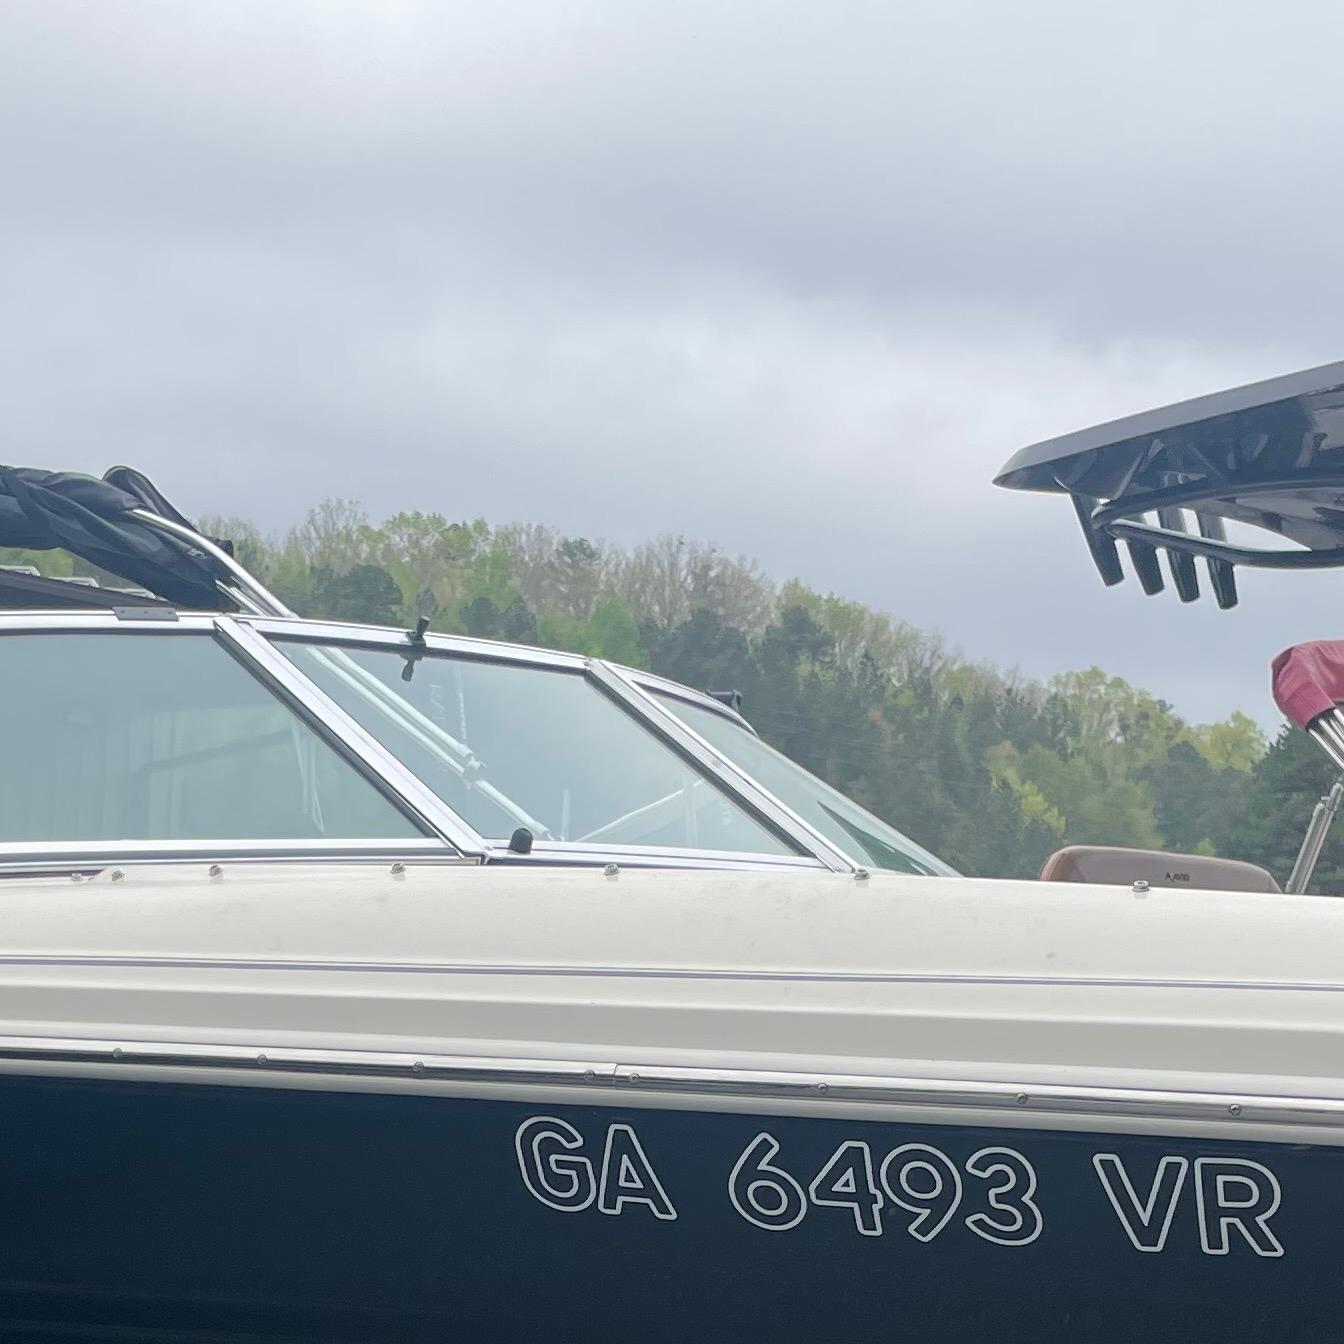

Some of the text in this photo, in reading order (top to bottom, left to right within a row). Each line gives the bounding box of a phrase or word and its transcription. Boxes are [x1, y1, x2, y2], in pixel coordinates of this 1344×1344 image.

[514, 1115, 1285, 1259] GA 6493 VR
